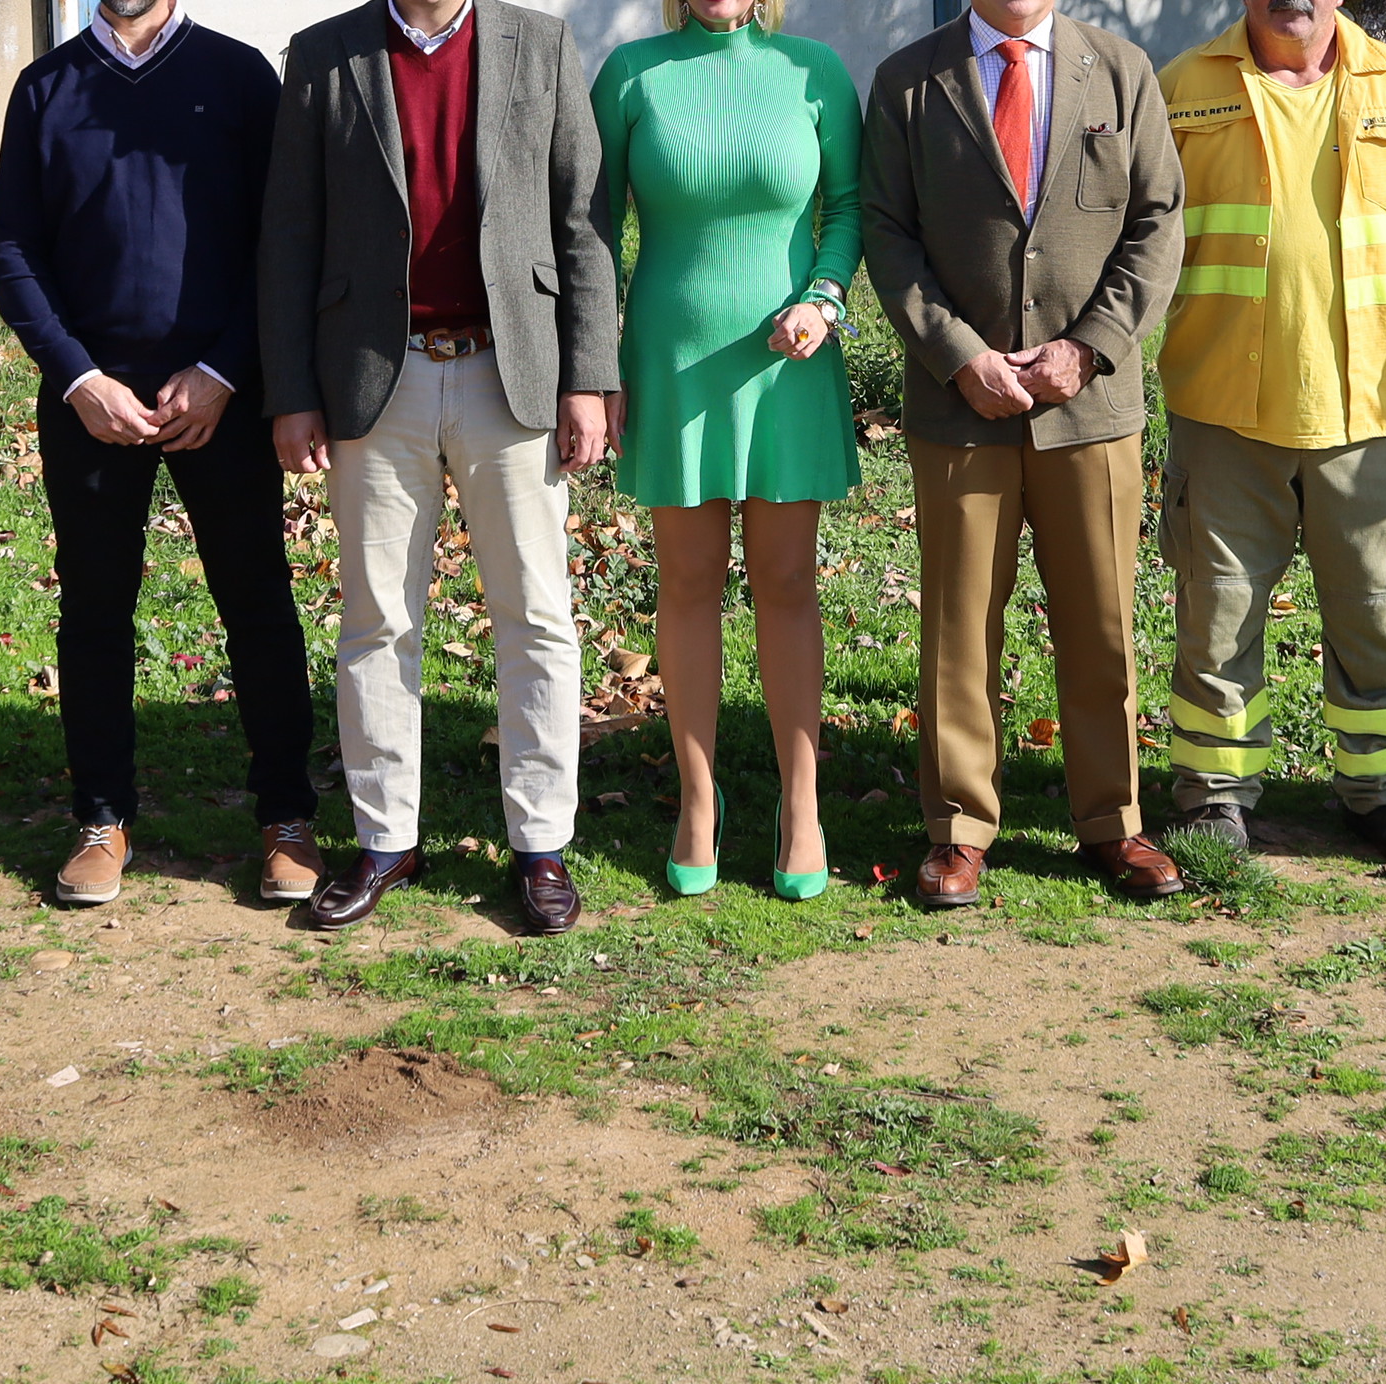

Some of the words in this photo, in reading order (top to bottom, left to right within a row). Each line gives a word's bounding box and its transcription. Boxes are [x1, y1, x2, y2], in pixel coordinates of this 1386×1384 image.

[1168, 110, 1191, 121] JEFE
[1194, 109, 1207, 118] DE
[1209, 104, 1242, 116] RETÉN
